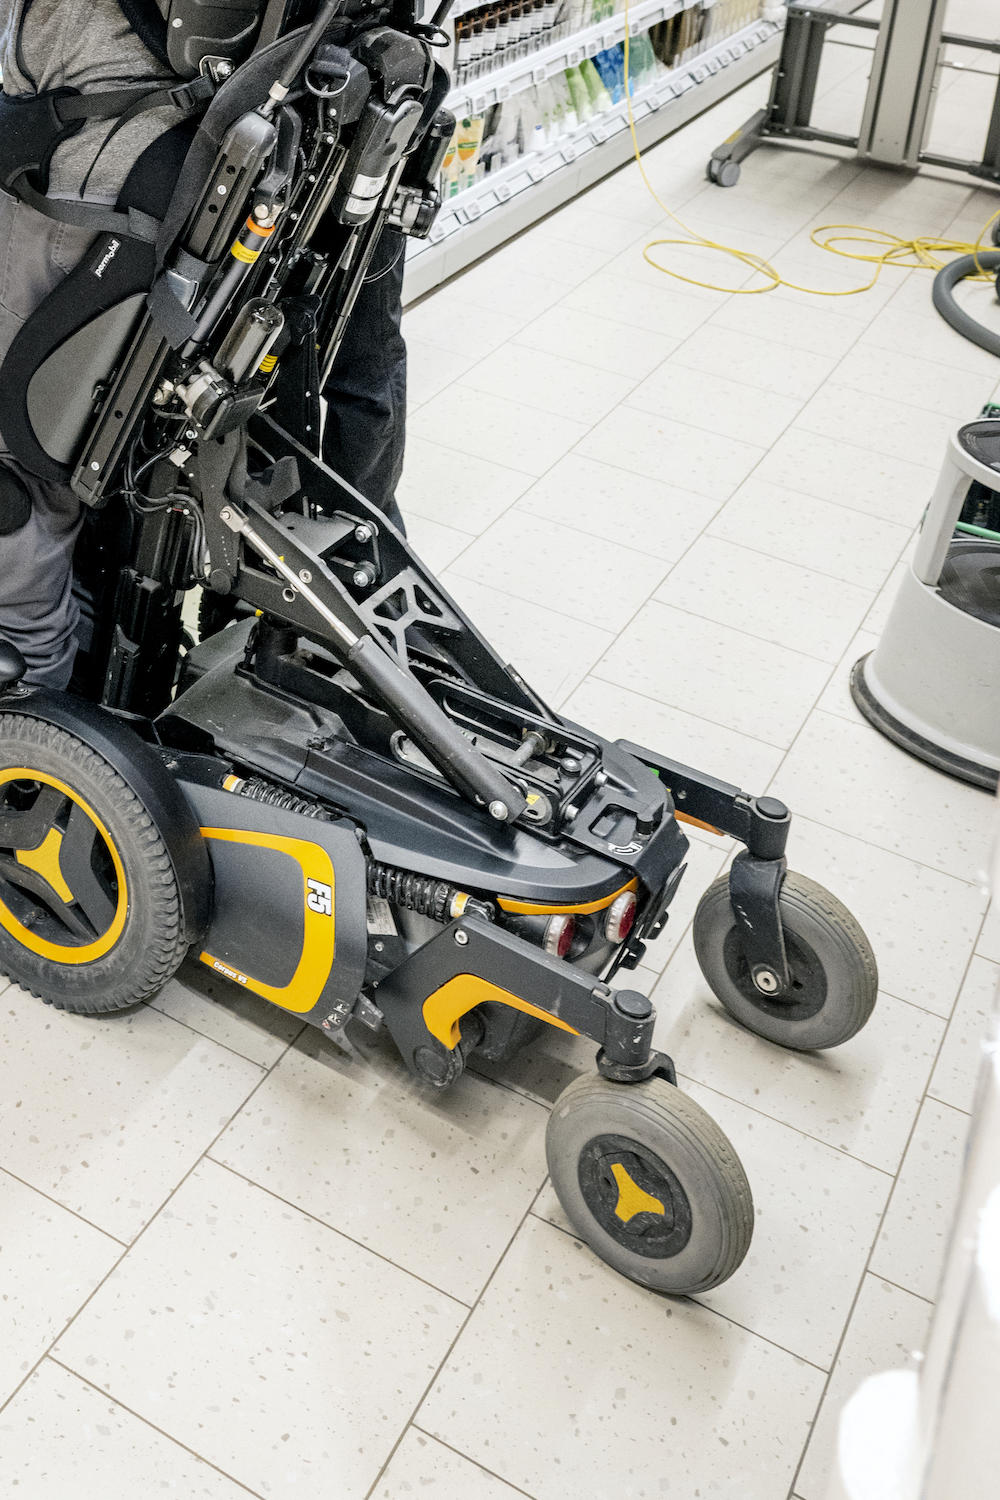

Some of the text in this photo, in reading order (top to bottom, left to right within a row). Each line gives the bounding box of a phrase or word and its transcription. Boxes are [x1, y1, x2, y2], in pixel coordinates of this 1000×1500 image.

[94, 239, 120, 278] permobil
[307, 877, 332, 917] F5
[213, 961, 248, 985] Corpus VS
